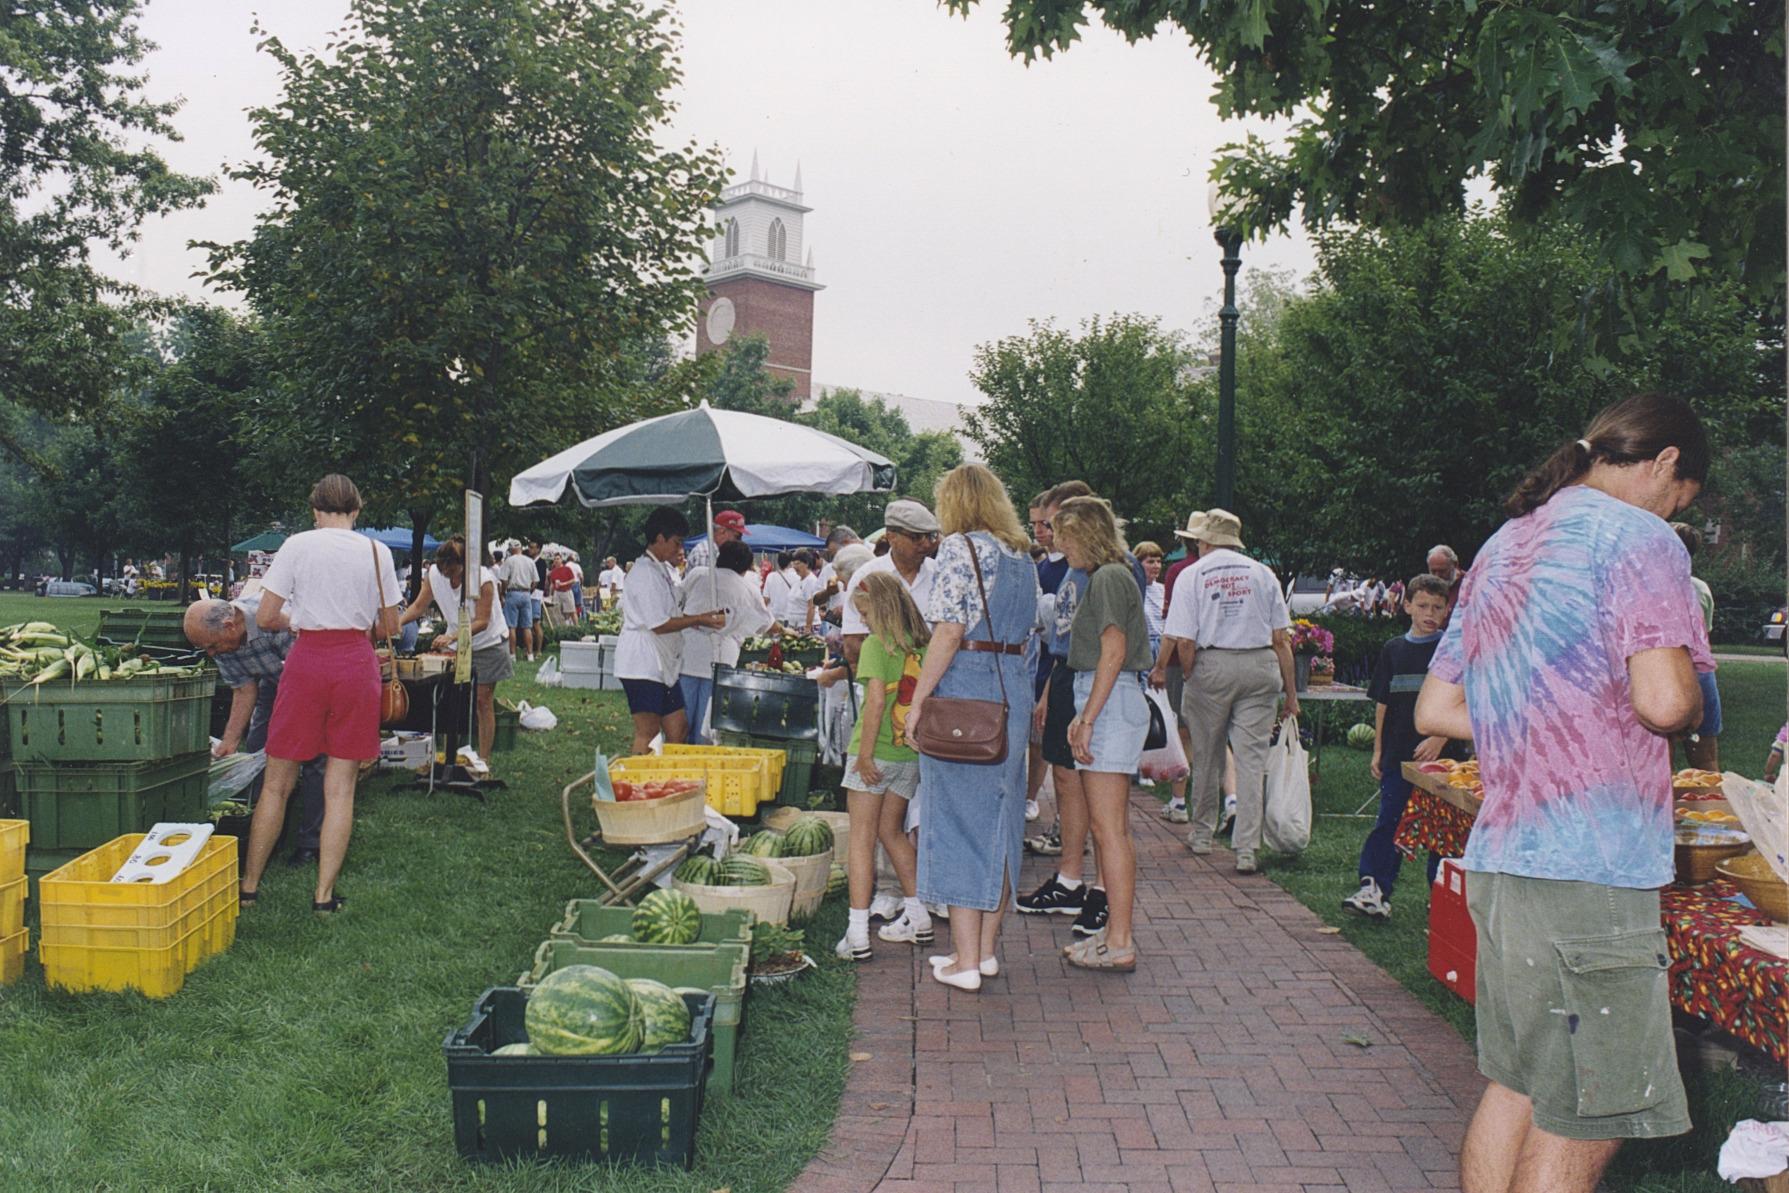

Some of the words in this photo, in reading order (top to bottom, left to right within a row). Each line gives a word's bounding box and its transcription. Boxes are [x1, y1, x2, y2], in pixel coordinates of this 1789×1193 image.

[1204, 575, 1250, 589] DEMOCRACY
[1220, 582, 1235, 590] NOT
[1227, 589, 1252, 597] SPORT
